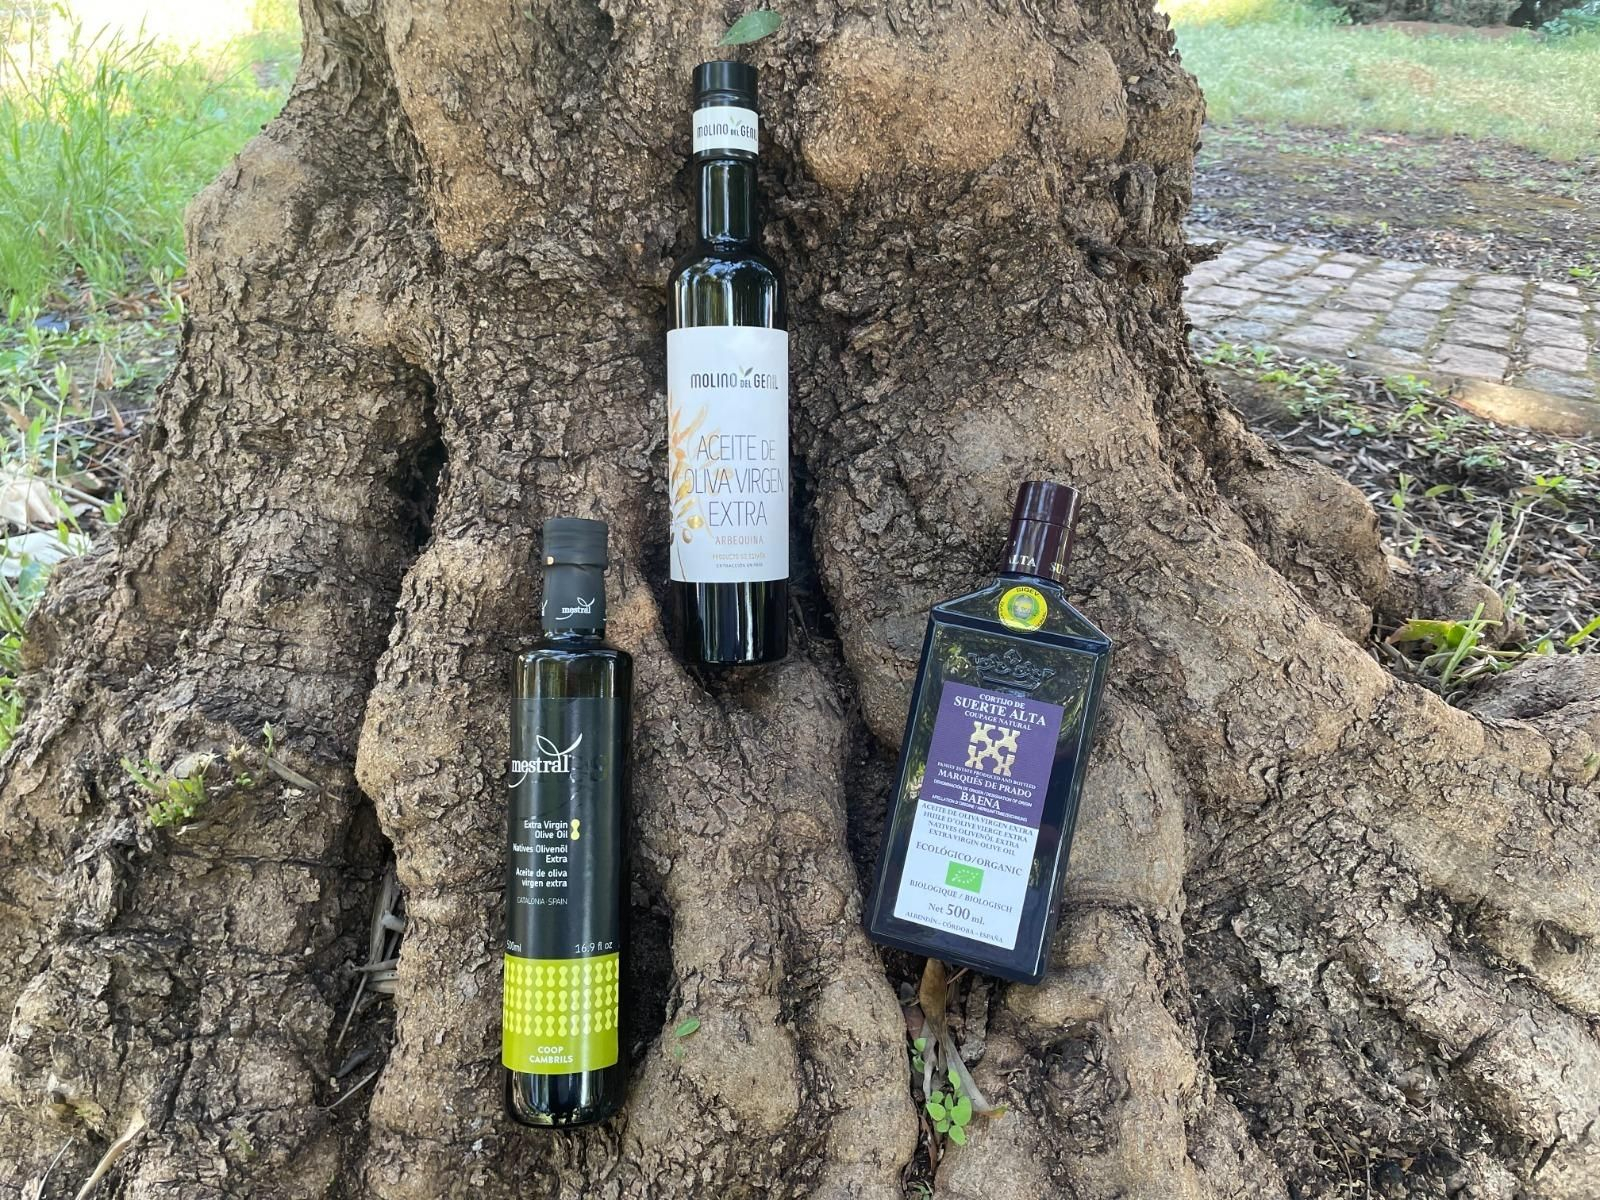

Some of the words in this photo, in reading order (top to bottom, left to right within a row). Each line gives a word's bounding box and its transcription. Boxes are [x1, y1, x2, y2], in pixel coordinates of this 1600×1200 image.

[697, 124, 729, 138] MOLINO
[691, 373, 738, 389] MOLINO
[740, 379, 752, 389] DEL
[697, 435, 757, 461] ACEITE
[761, 440, 776, 461] DE
[685, 468, 732, 494] OLIVA
[735, 468, 785, 494] VIRGEN
[709, 501, 768, 527] EXTRA
[715, 535, 765, 545] ARBEQUINA
[979, 693, 1013, 706] CORTIJO
[1014, 701, 1026, 710] DE
[953, 695, 1007, 717] SUERTE
[1009, 708, 1046, 726] ALTA
[964, 710, 997, 723] COUPAGE
[999, 718, 1032, 731] NATURAL
[937, 768, 983, 787] MARQUÉS
[984, 780, 998, 790] DE
[999, 783, 1033, 799] PRADO
[960, 791, 1001, 810] BAENA
[524, 820, 542, 829] Extra
[543, 820, 568, 831] Virgin
[921, 802, 947, 815] ACEITE
[947, 809, 957, 817] DE
[959, 812, 980, 822] OLIVA
[980, 817, 1008, 830] VIRGEN
[1008, 824, 1033, 836] EXTRA
[923, 811, 946, 822] HUILE
[977, 823, 1004, 836] VIERGE
[1003, 830, 1028, 843] EXTRA
[534, 830, 554, 839] Olive
[556, 830, 568, 839] Oil
[928, 820, 957, 832] NATIVES
[995, 838, 1019, 849] EXTRA
[928, 828, 953, 840] EXTRA
[952, 835, 979, 847] VIRGIN
[980, 842, 1001, 853] OLIVE
[1002, 848, 1016, 857] OIL
[512, 843, 534, 853] Natives
[535, 845, 568, 853] Olivenöl
[545, 854, 568, 863] Extra
[516, 867, 534, 877] Aceite
[536, 868, 546, 877] de
[547, 869, 568, 877] oliva
[521, 879, 544, 888] virgen
[547, 897, 568, 906] SPAIN
[909, 879, 957, 898] BIOLOGIQUE
[964, 894, 1013, 913] BIOLOGISCH
[928, 902, 944, 914] Net
[946, 903, 971, 921] 500
[979, 932, 1003, 943] ESPAÑA
[575, 943, 595, 953] 16.9
[597, 941, 603, 951] fl
[604, 941, 613, 949] oz
[538, 1046, 564, 1054] COOP
[529, 1055, 574, 1064] CAMBRILS
